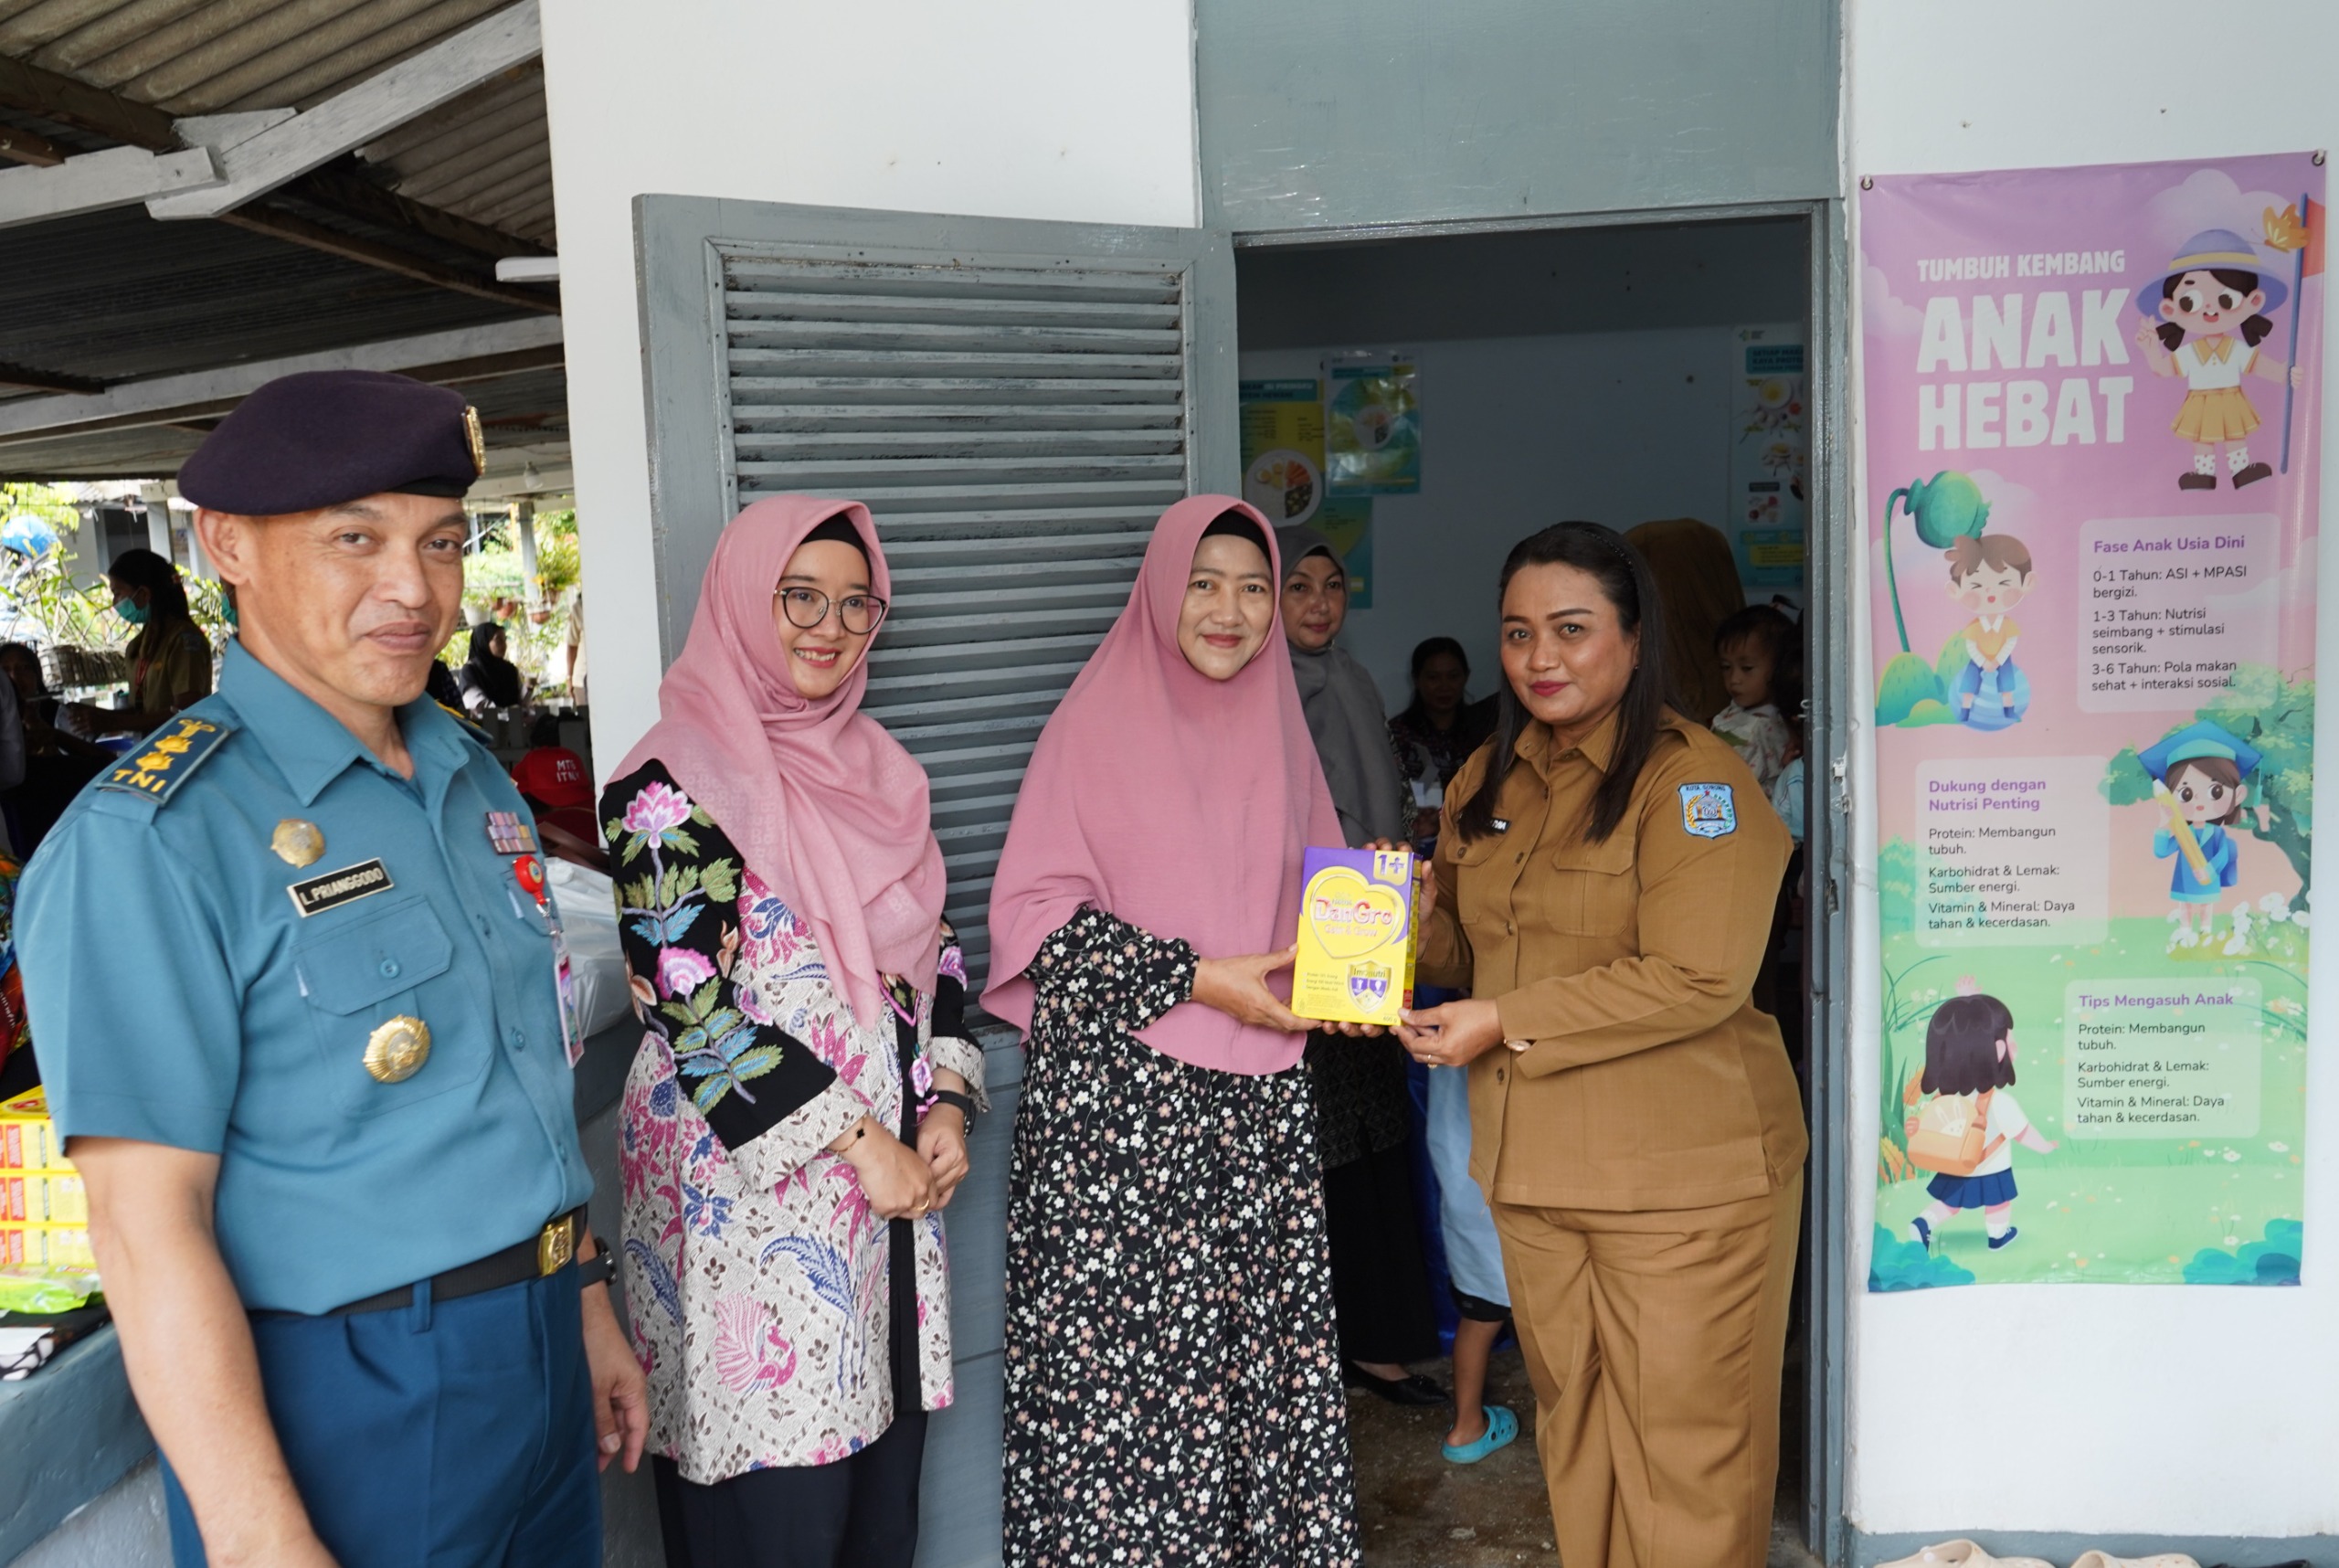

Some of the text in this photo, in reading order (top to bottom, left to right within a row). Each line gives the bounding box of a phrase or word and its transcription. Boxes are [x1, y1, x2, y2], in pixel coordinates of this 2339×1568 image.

[1918, 250, 2124, 282] TUMBUH KEMBANG
[1916, 288, 2131, 373] ANAK
[1919, 376, 2134, 450] HEBAT
[2094, 535, 2244, 553] Fase Anak Usia Dini
[2093, 570, 2115, 582] 0-1
[2120, 569, 2162, 581] Tahun:
[2165, 567, 2187, 579] ASI
[2205, 566, 2247, 577] MPASI
[2093, 586, 2137, 599] bergizi.
[2094, 608, 2206, 622] 1-3 Tahun: Nutrisi
[2093, 626, 2153, 639] seimbang
[2169, 623, 2224, 636] stimulasi
[2092, 641, 2146, 654] sensorik.
[2092, 660, 2237, 675] 3-6 Tahun: Pola makan
[2092, 680, 2126, 691] sehat
[2142, 677, 2193, 689] interaksi
[2197, 676, 2236, 688] sosial.
[112, 769, 166, 793] TNI
[1930, 779, 2046, 794] Dukung dengan
[1930, 797, 2039, 811] Nutrisi Penting
[1930, 827, 2056, 839] Protein: Membangun
[1929, 843, 1966, 854] tubuh.
[1378, 854, 1404, 875] 1+
[1929, 864, 2059, 877] Karbohidrat & Lemak:
[1929, 881, 2019, 894] Sumber energi.
[1314, 897, 1394, 926] DanGro
[1929, 900, 2075, 913] Vitamin & Mineral: Daya
[1929, 916, 2050, 929] tahan & kecerdasan.
[2079, 993, 2233, 1009] Tips Mengasuh Anak
[2079, 1023, 2205, 1035] Protein: Membangun
[2078, 1039, 2116, 1050] tubuh.
[2079, 1061, 2208, 1073] Karbohidrat & Lemak:
[2078, 1076, 2169, 1089] Sumber energi.
[2078, 1096, 2224, 1108] Vitamin & Mineral: Daya
[2078, 1112, 2199, 1123] tahan & kecerdasan.
